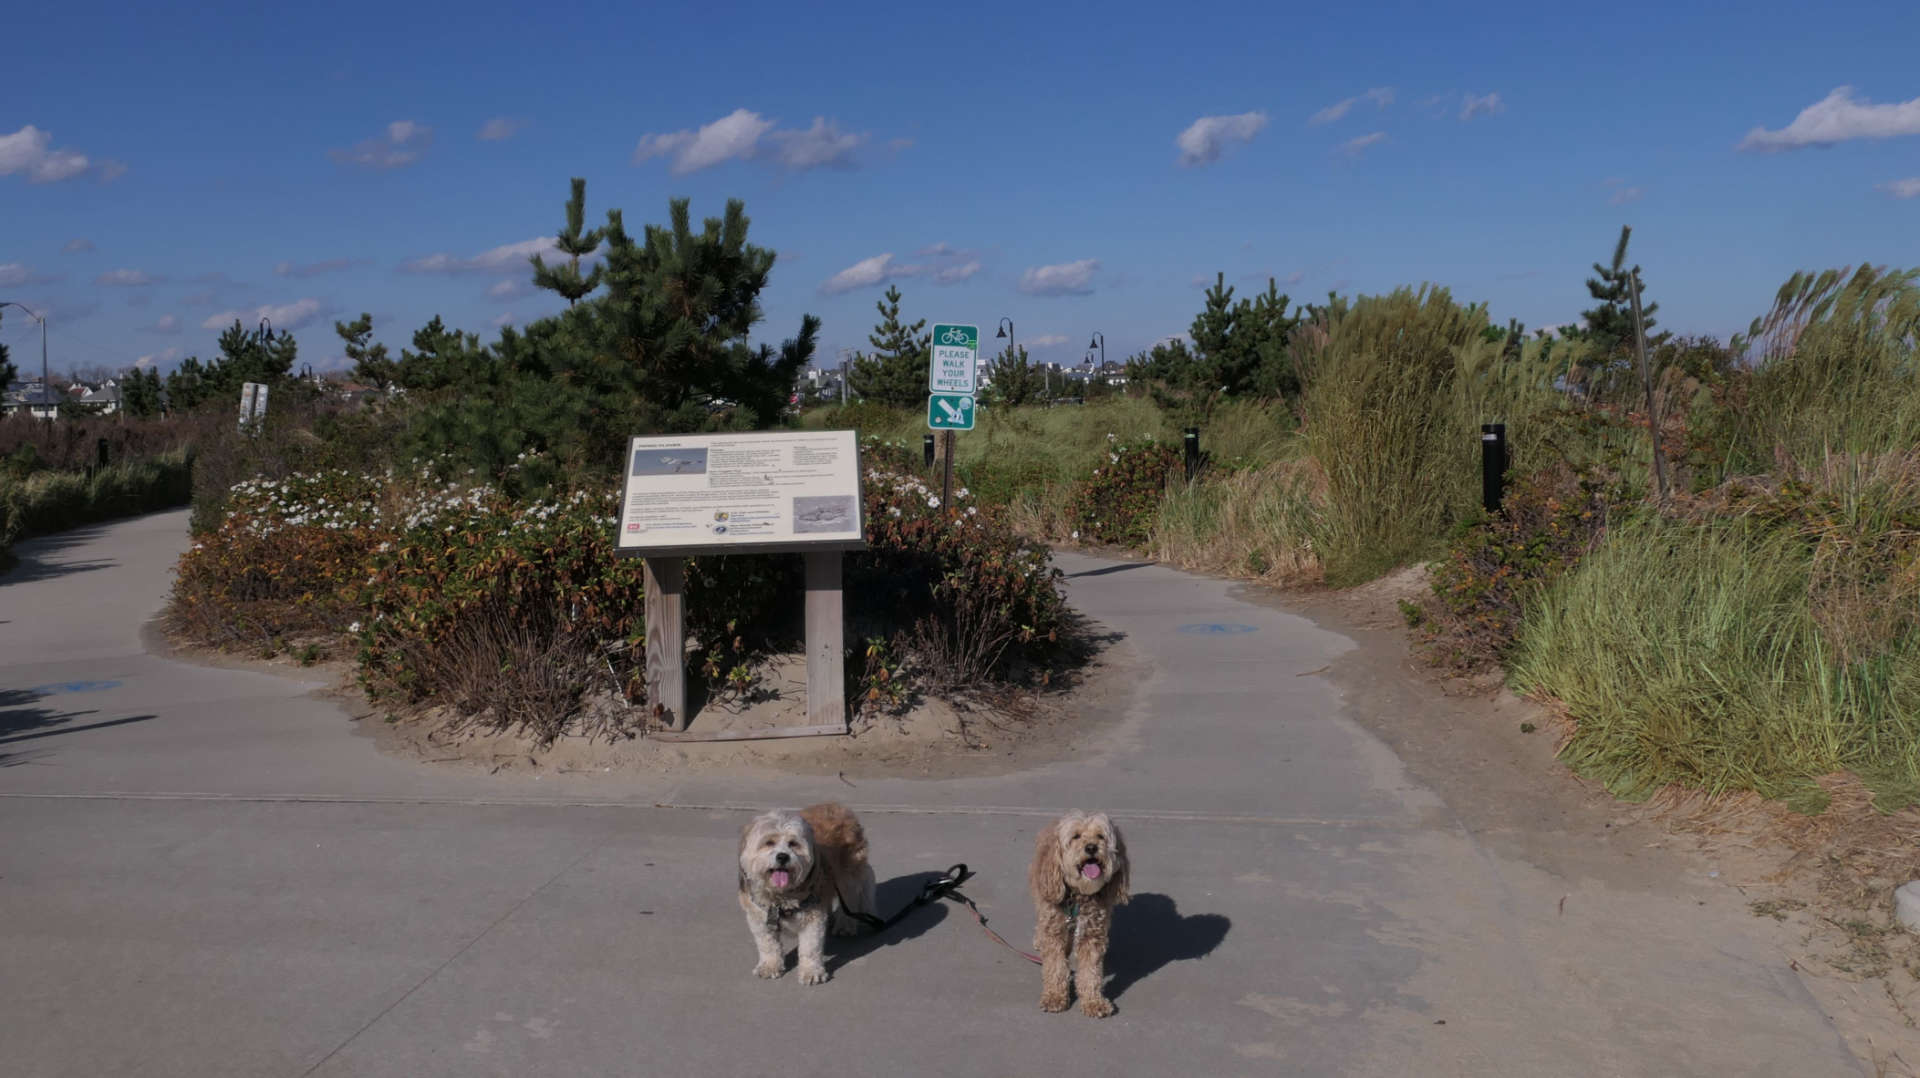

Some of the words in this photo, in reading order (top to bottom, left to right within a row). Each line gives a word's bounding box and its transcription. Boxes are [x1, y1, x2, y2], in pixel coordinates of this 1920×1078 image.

[939, 350, 969, 359] PLEASE
[943, 360, 965, 368] WALK
[943, 369, 964, 377] YOUR
[937, 379, 969, 387] WHEELS
